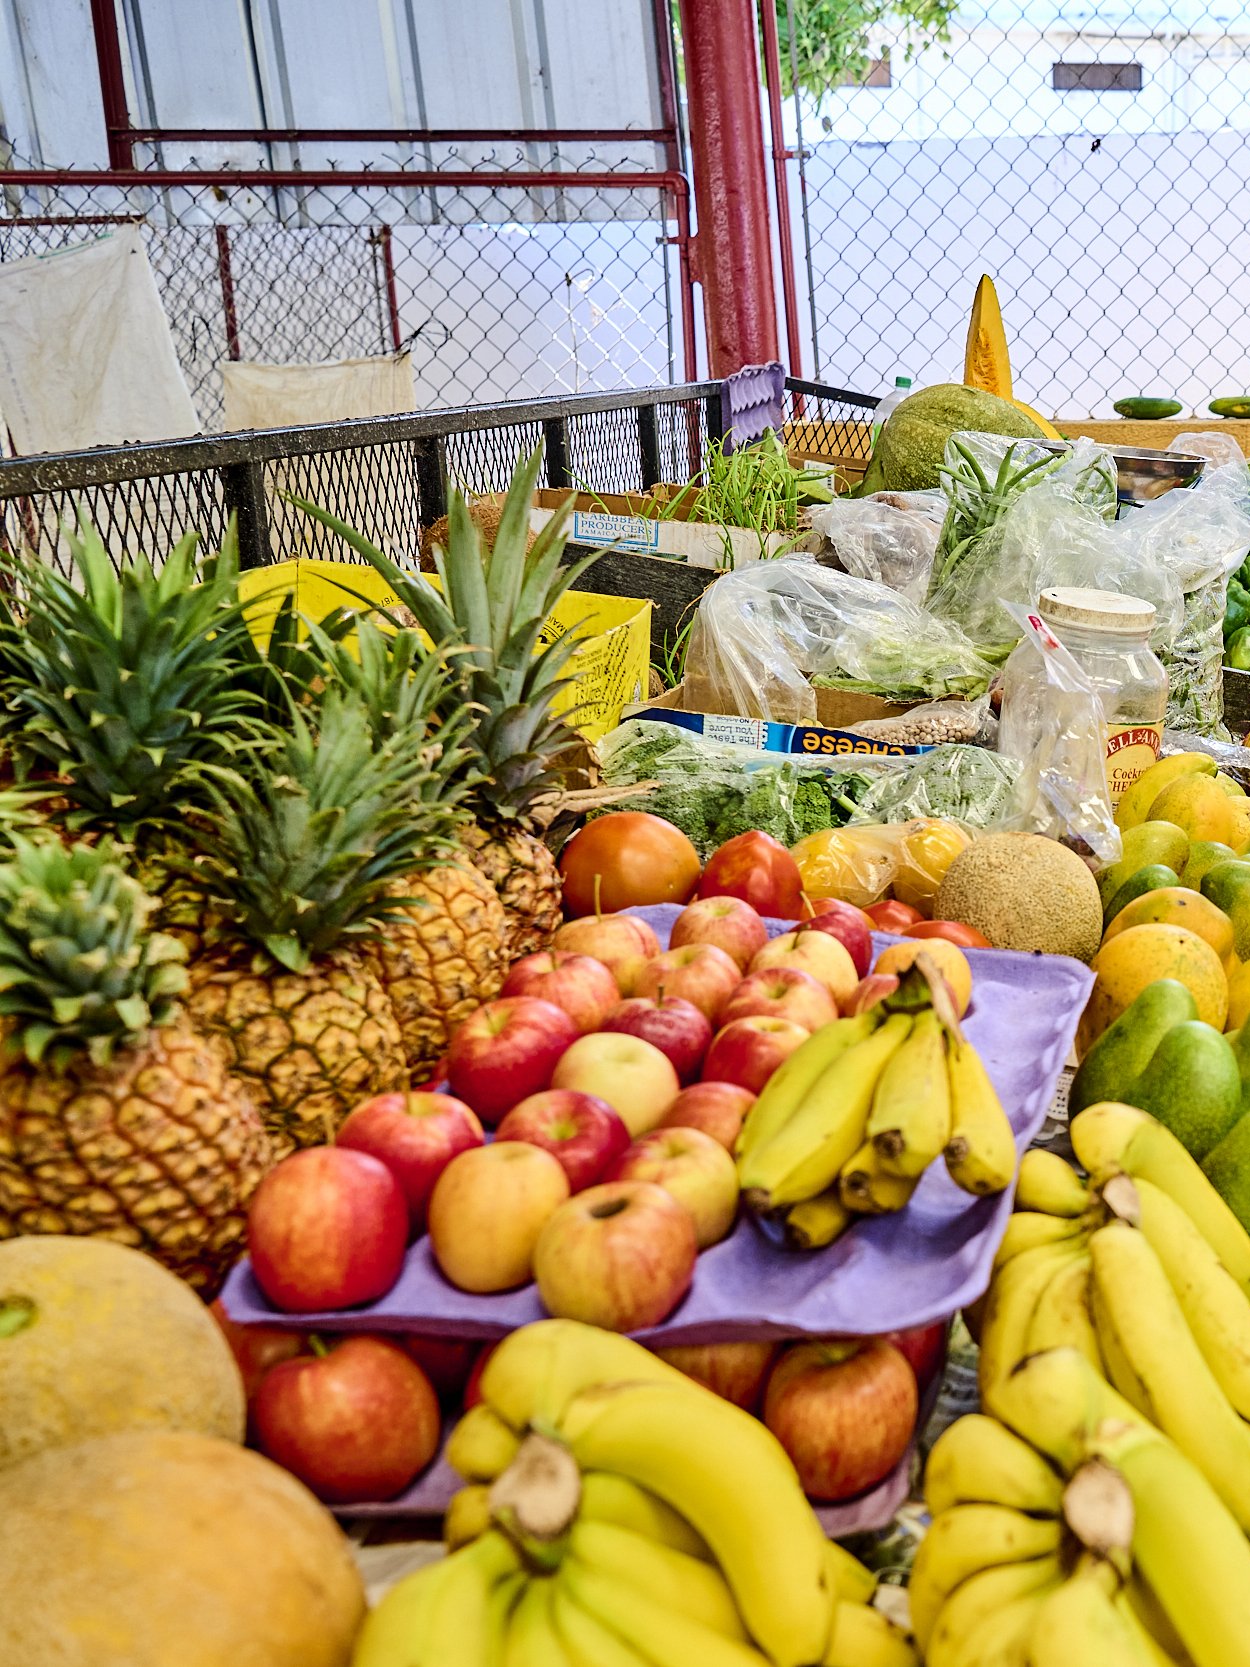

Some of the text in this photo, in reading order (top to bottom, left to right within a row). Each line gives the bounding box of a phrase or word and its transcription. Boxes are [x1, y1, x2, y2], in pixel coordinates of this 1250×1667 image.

[581, 520, 652, 535] PRODUCERS
[581, 529, 616, 537] JAMAICA
[708, 725, 753, 735] You Love
[739, 736, 755, 745] The
